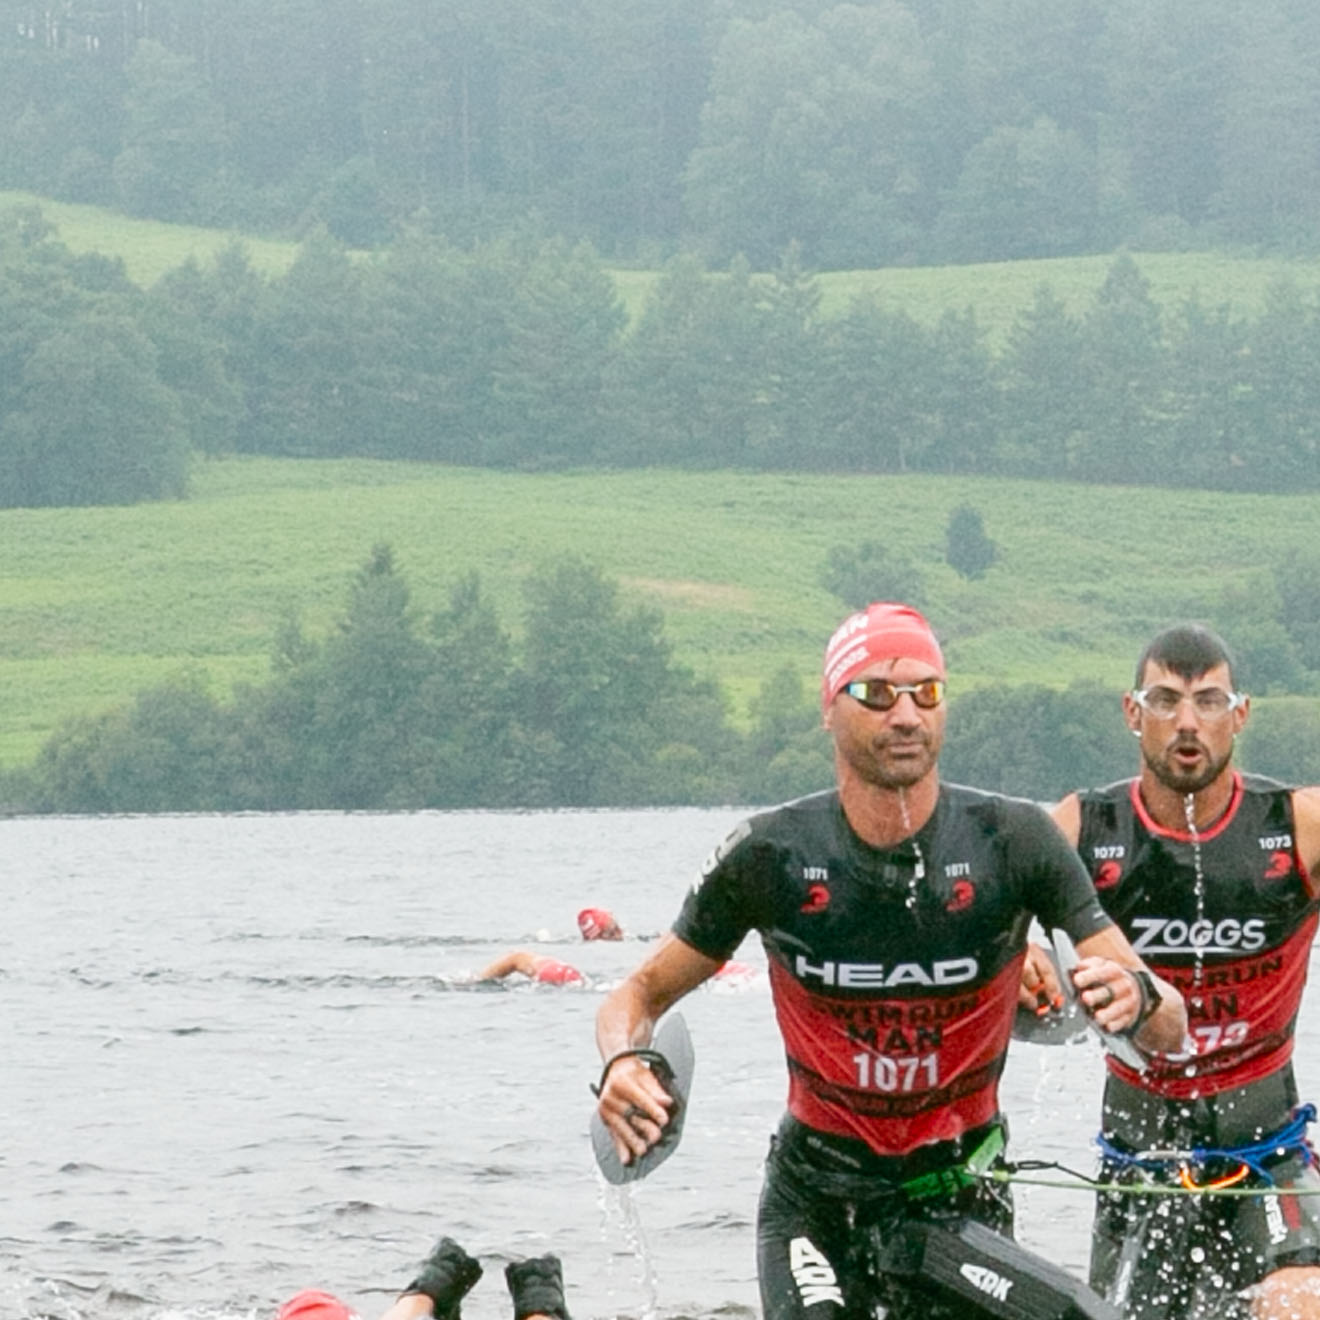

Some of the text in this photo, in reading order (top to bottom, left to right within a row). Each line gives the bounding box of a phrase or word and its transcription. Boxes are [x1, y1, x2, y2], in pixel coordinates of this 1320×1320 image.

[1093, 845, 1125, 859] 1073
[1258, 835, 1293, 850] 1073
[803, 866, 829, 881] 1071
[943, 862, 970, 878] 1071
[1131, 918, 1266, 954] ZOGGS
[796, 955, 979, 988] HEAD
[1188, 993, 1239, 1019] AN
[848, 1024, 943, 1051] MAN
[853, 1053, 938, 1092] 1071
[790, 1236, 845, 1307] ARK
[959, 1263, 1014, 1302] ARK
